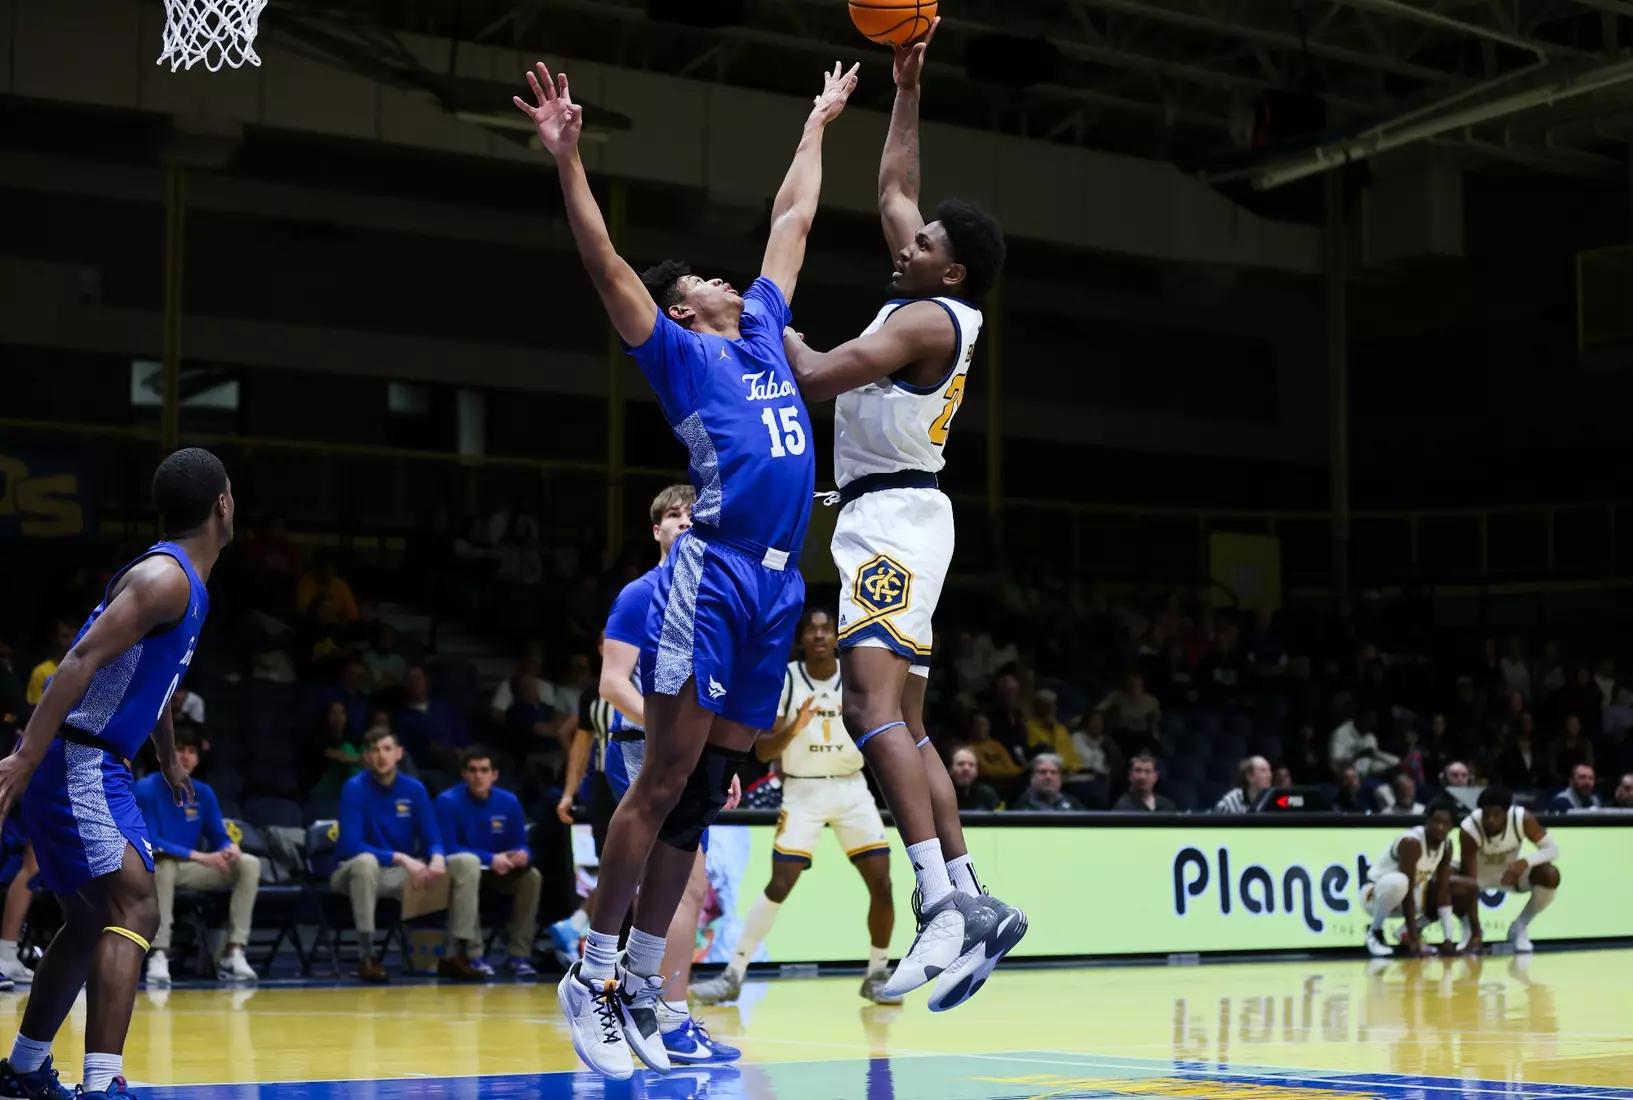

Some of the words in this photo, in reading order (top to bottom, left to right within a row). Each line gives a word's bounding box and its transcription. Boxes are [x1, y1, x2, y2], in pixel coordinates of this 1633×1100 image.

[761, 405, 806, 458] 15
[822, 719, 831, 743] 1
[809, 744, 843, 753] CITY
